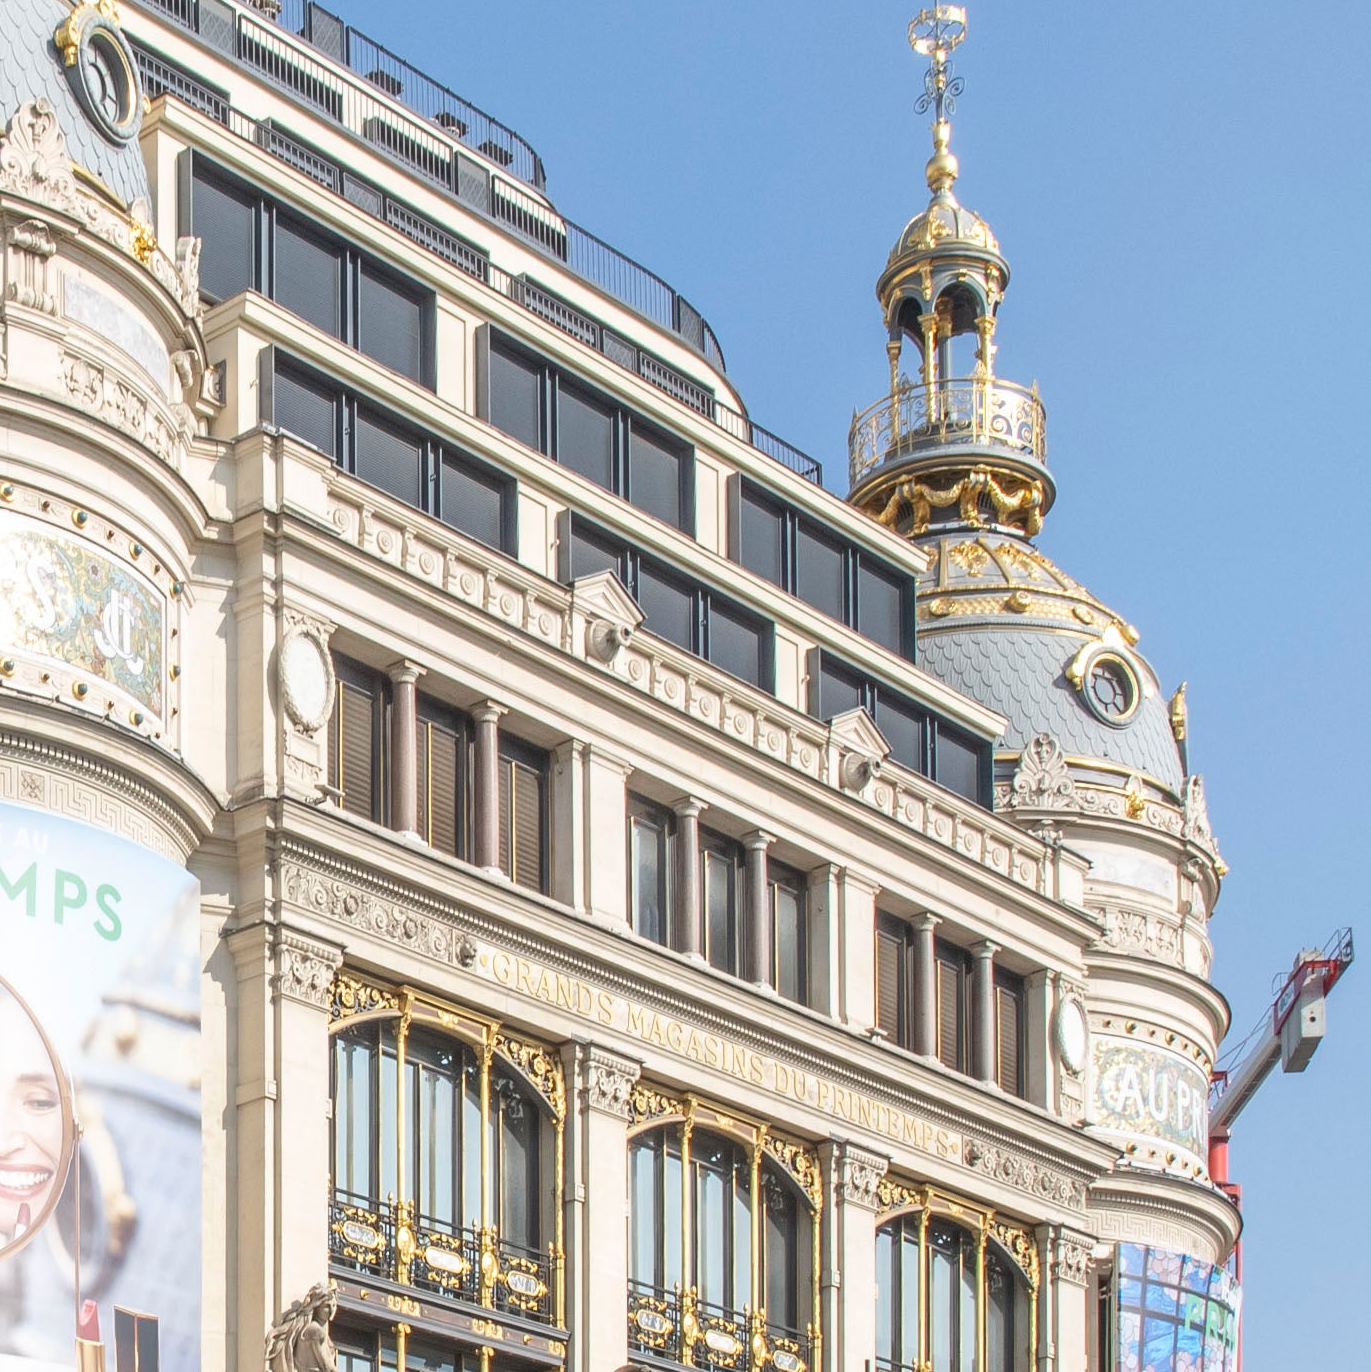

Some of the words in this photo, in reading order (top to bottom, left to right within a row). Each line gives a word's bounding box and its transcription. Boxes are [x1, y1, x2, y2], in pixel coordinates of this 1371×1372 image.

[14, 831, 49, 854] AU
[493, 951, 615, 1026] GRANDS
[626, 1002, 764, 1085] MAGASINS
[774, 1061, 808, 1101] DU
[816, 1079, 950, 1158] PRINTEMPS
